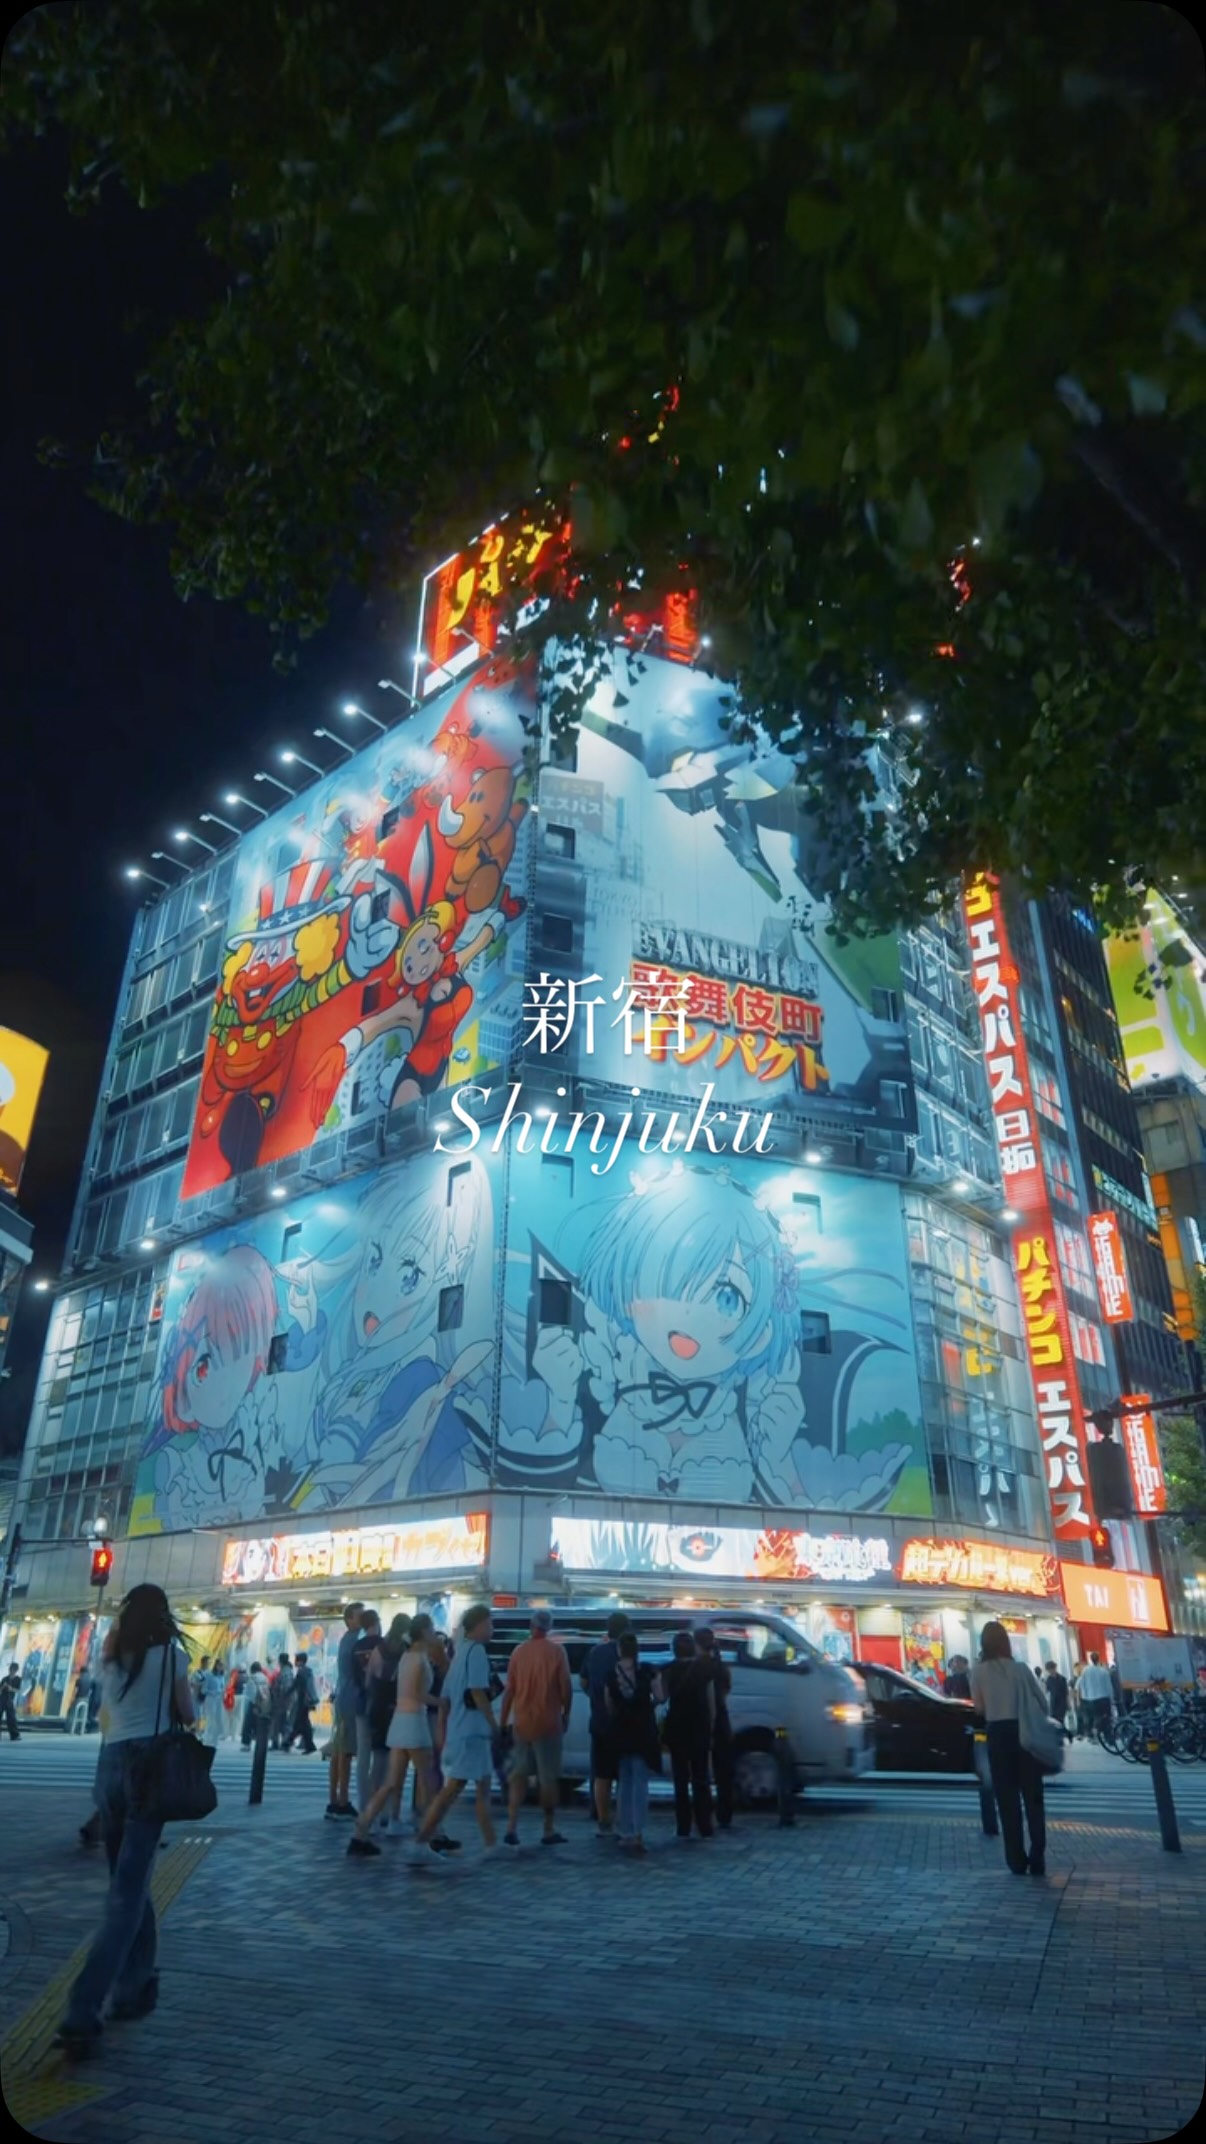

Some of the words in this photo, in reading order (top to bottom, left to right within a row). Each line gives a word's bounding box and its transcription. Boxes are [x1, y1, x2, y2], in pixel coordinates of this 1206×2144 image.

[1017, 1236, 1064, 1367] パチンコ
[1037, 1380, 1091, 1526] エスパス
